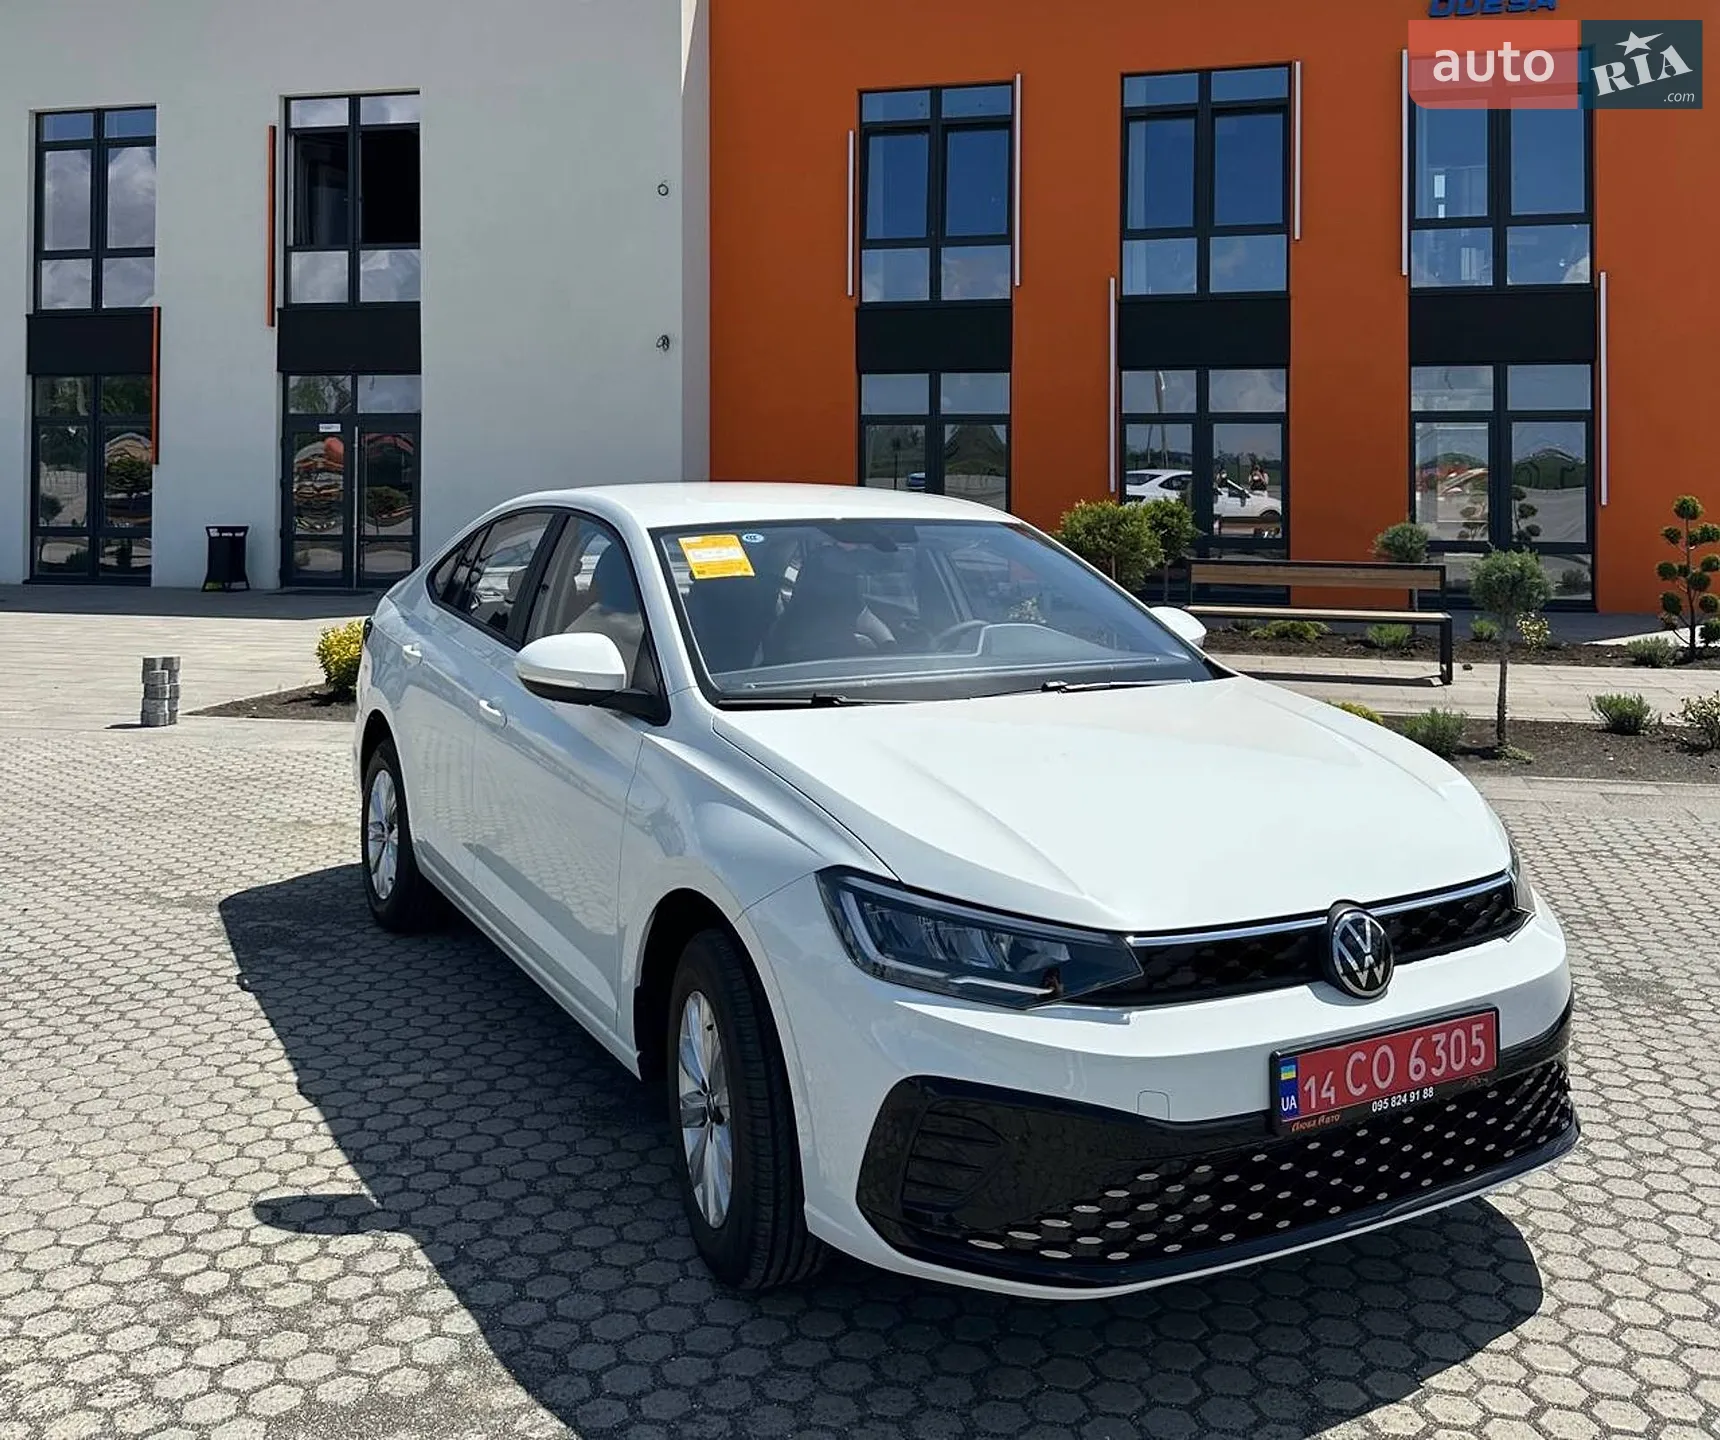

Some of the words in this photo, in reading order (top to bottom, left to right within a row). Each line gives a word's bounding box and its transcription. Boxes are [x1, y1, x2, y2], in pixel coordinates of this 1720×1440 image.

[1303, 1071, 1336, 1109] 14
[1345, 1044, 1396, 1097] CO
[1408, 1023, 1486, 1083] 6305
[1281, 1094, 1298, 1112] UA
[1371, 1098, 1389, 1113] 095
[1390, 1093, 1407, 1107] 824
[1409, 1090, 1420, 1102] 91
[1422, 1086, 1434, 1099] 88
